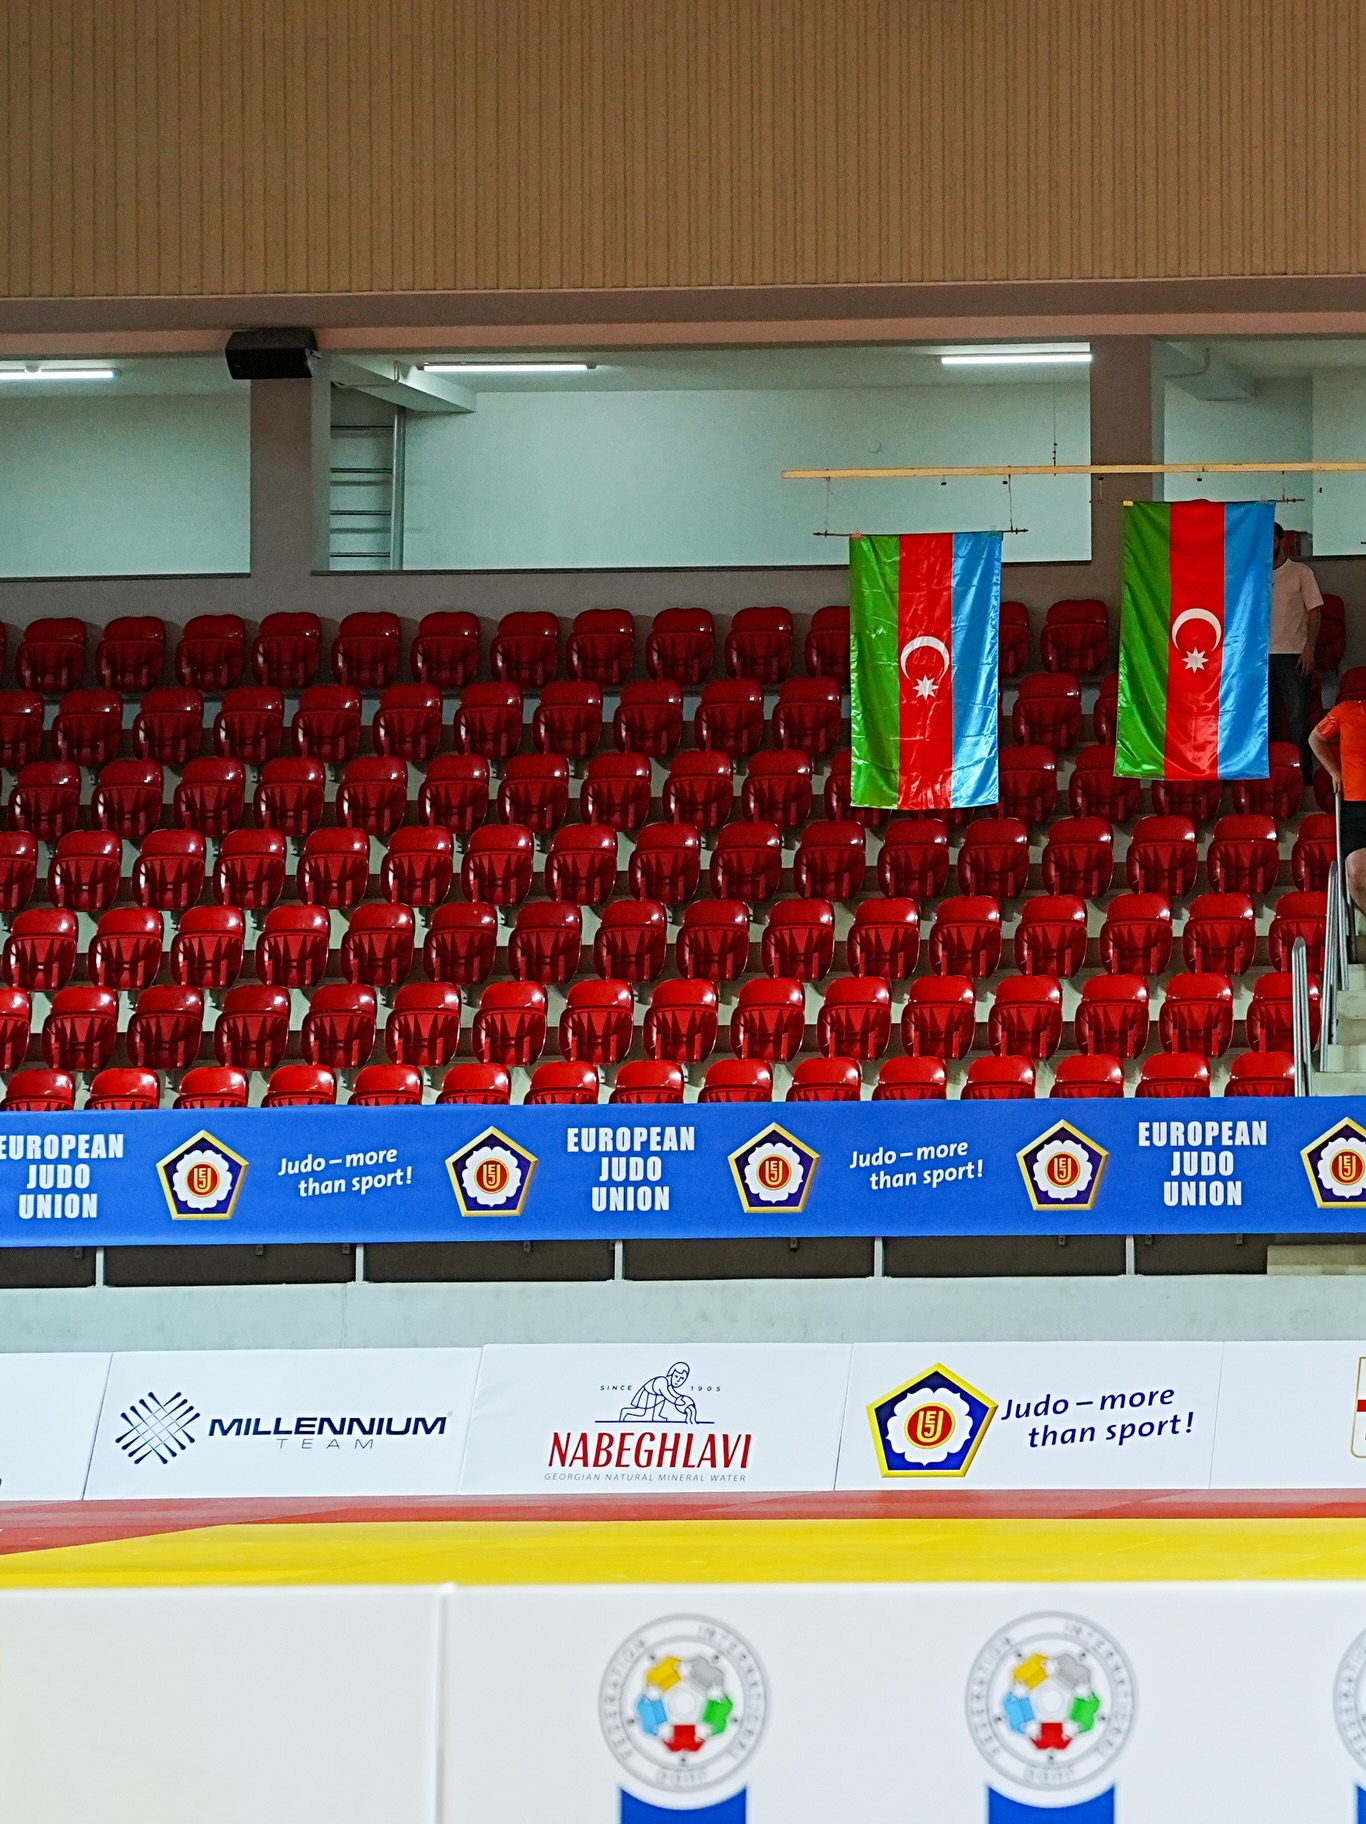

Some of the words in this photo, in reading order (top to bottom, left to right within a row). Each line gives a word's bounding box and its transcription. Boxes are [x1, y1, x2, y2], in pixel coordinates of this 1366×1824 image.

[568, 1127, 694, 1152] EUROPEAN
[1139, 1121, 1266, 1146] EUROPEAN
[278, 1154, 326, 1176] Judo
[346, 1149, 397, 1167] more
[850, 1147, 896, 1168] Judo
[917, 1142, 968, 1160] more
[1171, 1151, 1233, 1176] JUDO
[27, 1164, 89, 1189] JUDO
[298, 1178, 346, 1197] than
[352, 1166, 412, 1195] sport!
[600, 1157, 661, 1181] JUDO
[870, 1171, 917, 1190] than
[923, 1159, 983, 1188] sport!
[592, 1186, 669, 1211] UNION
[1164, 1181, 1241, 1206] UNION
[19, 1194, 97, 1219] UNION
[1001, 1394, 1069, 1420] Judo
[1100, 1388, 1174, 1410] more
[208, 1416, 447, 1437] MILLENNIUM
[1028, 1425, 1095, 1448] than
[1106, 1411, 1194, 1446] sport!
[276, 1438, 374, 1449] TEAM
[548, 1432, 751, 1469] NABEGHLAVI
[544, 1473, 600, 1481] GEORGIAN
[658, 1474, 705, 1482] MINERAL
[710, 1474, 746, 1482] WATER
